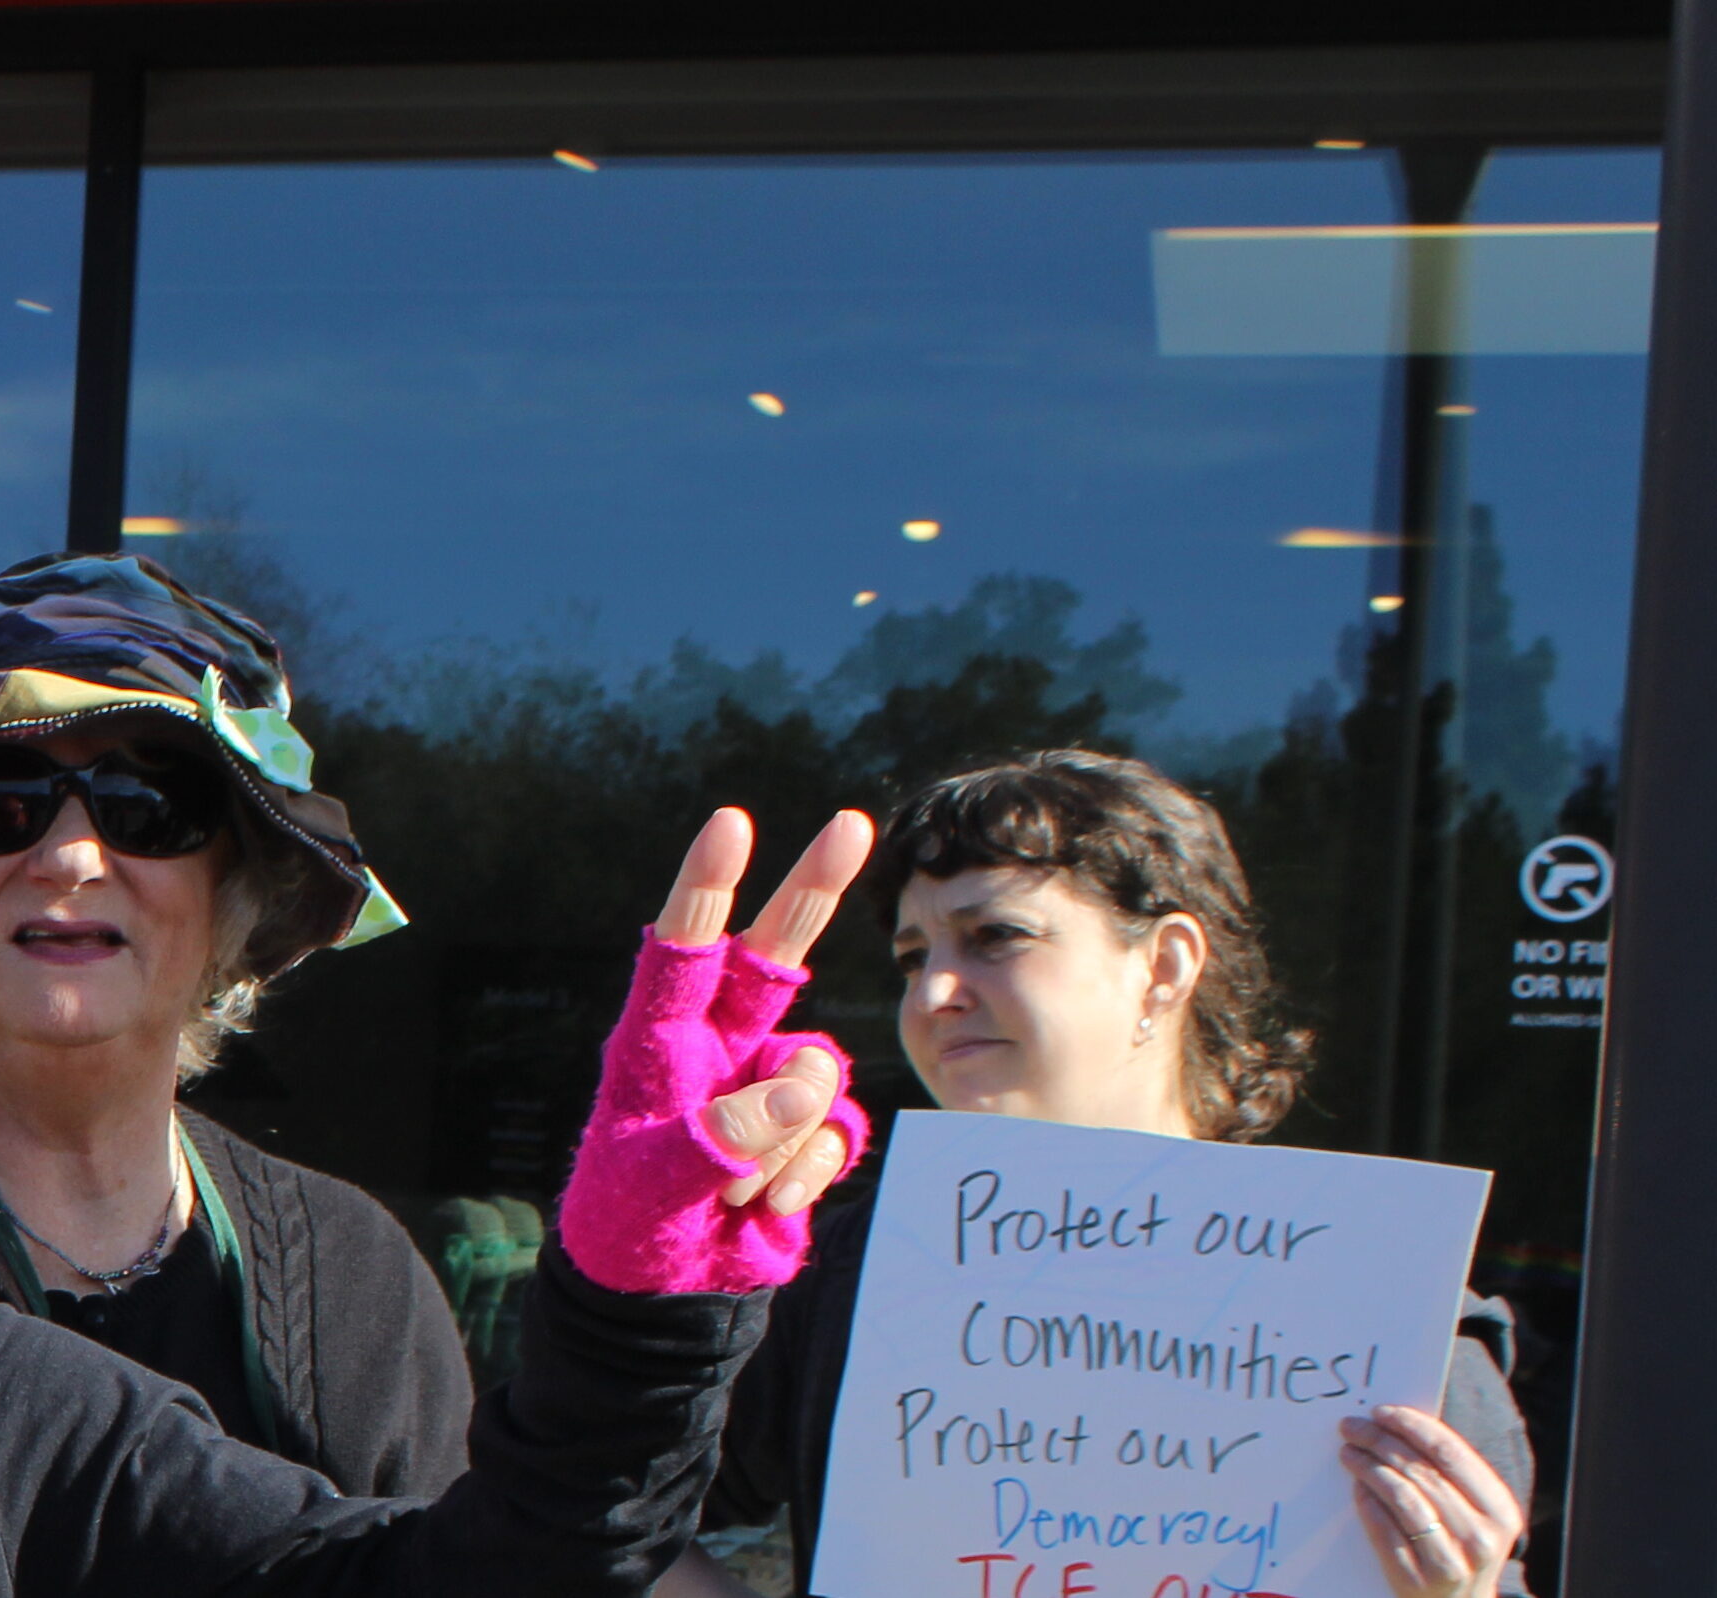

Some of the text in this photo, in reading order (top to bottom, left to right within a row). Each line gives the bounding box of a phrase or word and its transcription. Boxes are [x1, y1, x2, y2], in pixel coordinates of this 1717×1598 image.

[1511, 973, 1561, 999] OR
[1513, 938, 1566, 965] NO
[954, 1169, 1332, 1266] Protect our
[897, 1387, 1262, 1479] Protect our
[992, 1476, 1280, 1592] Democracy!
